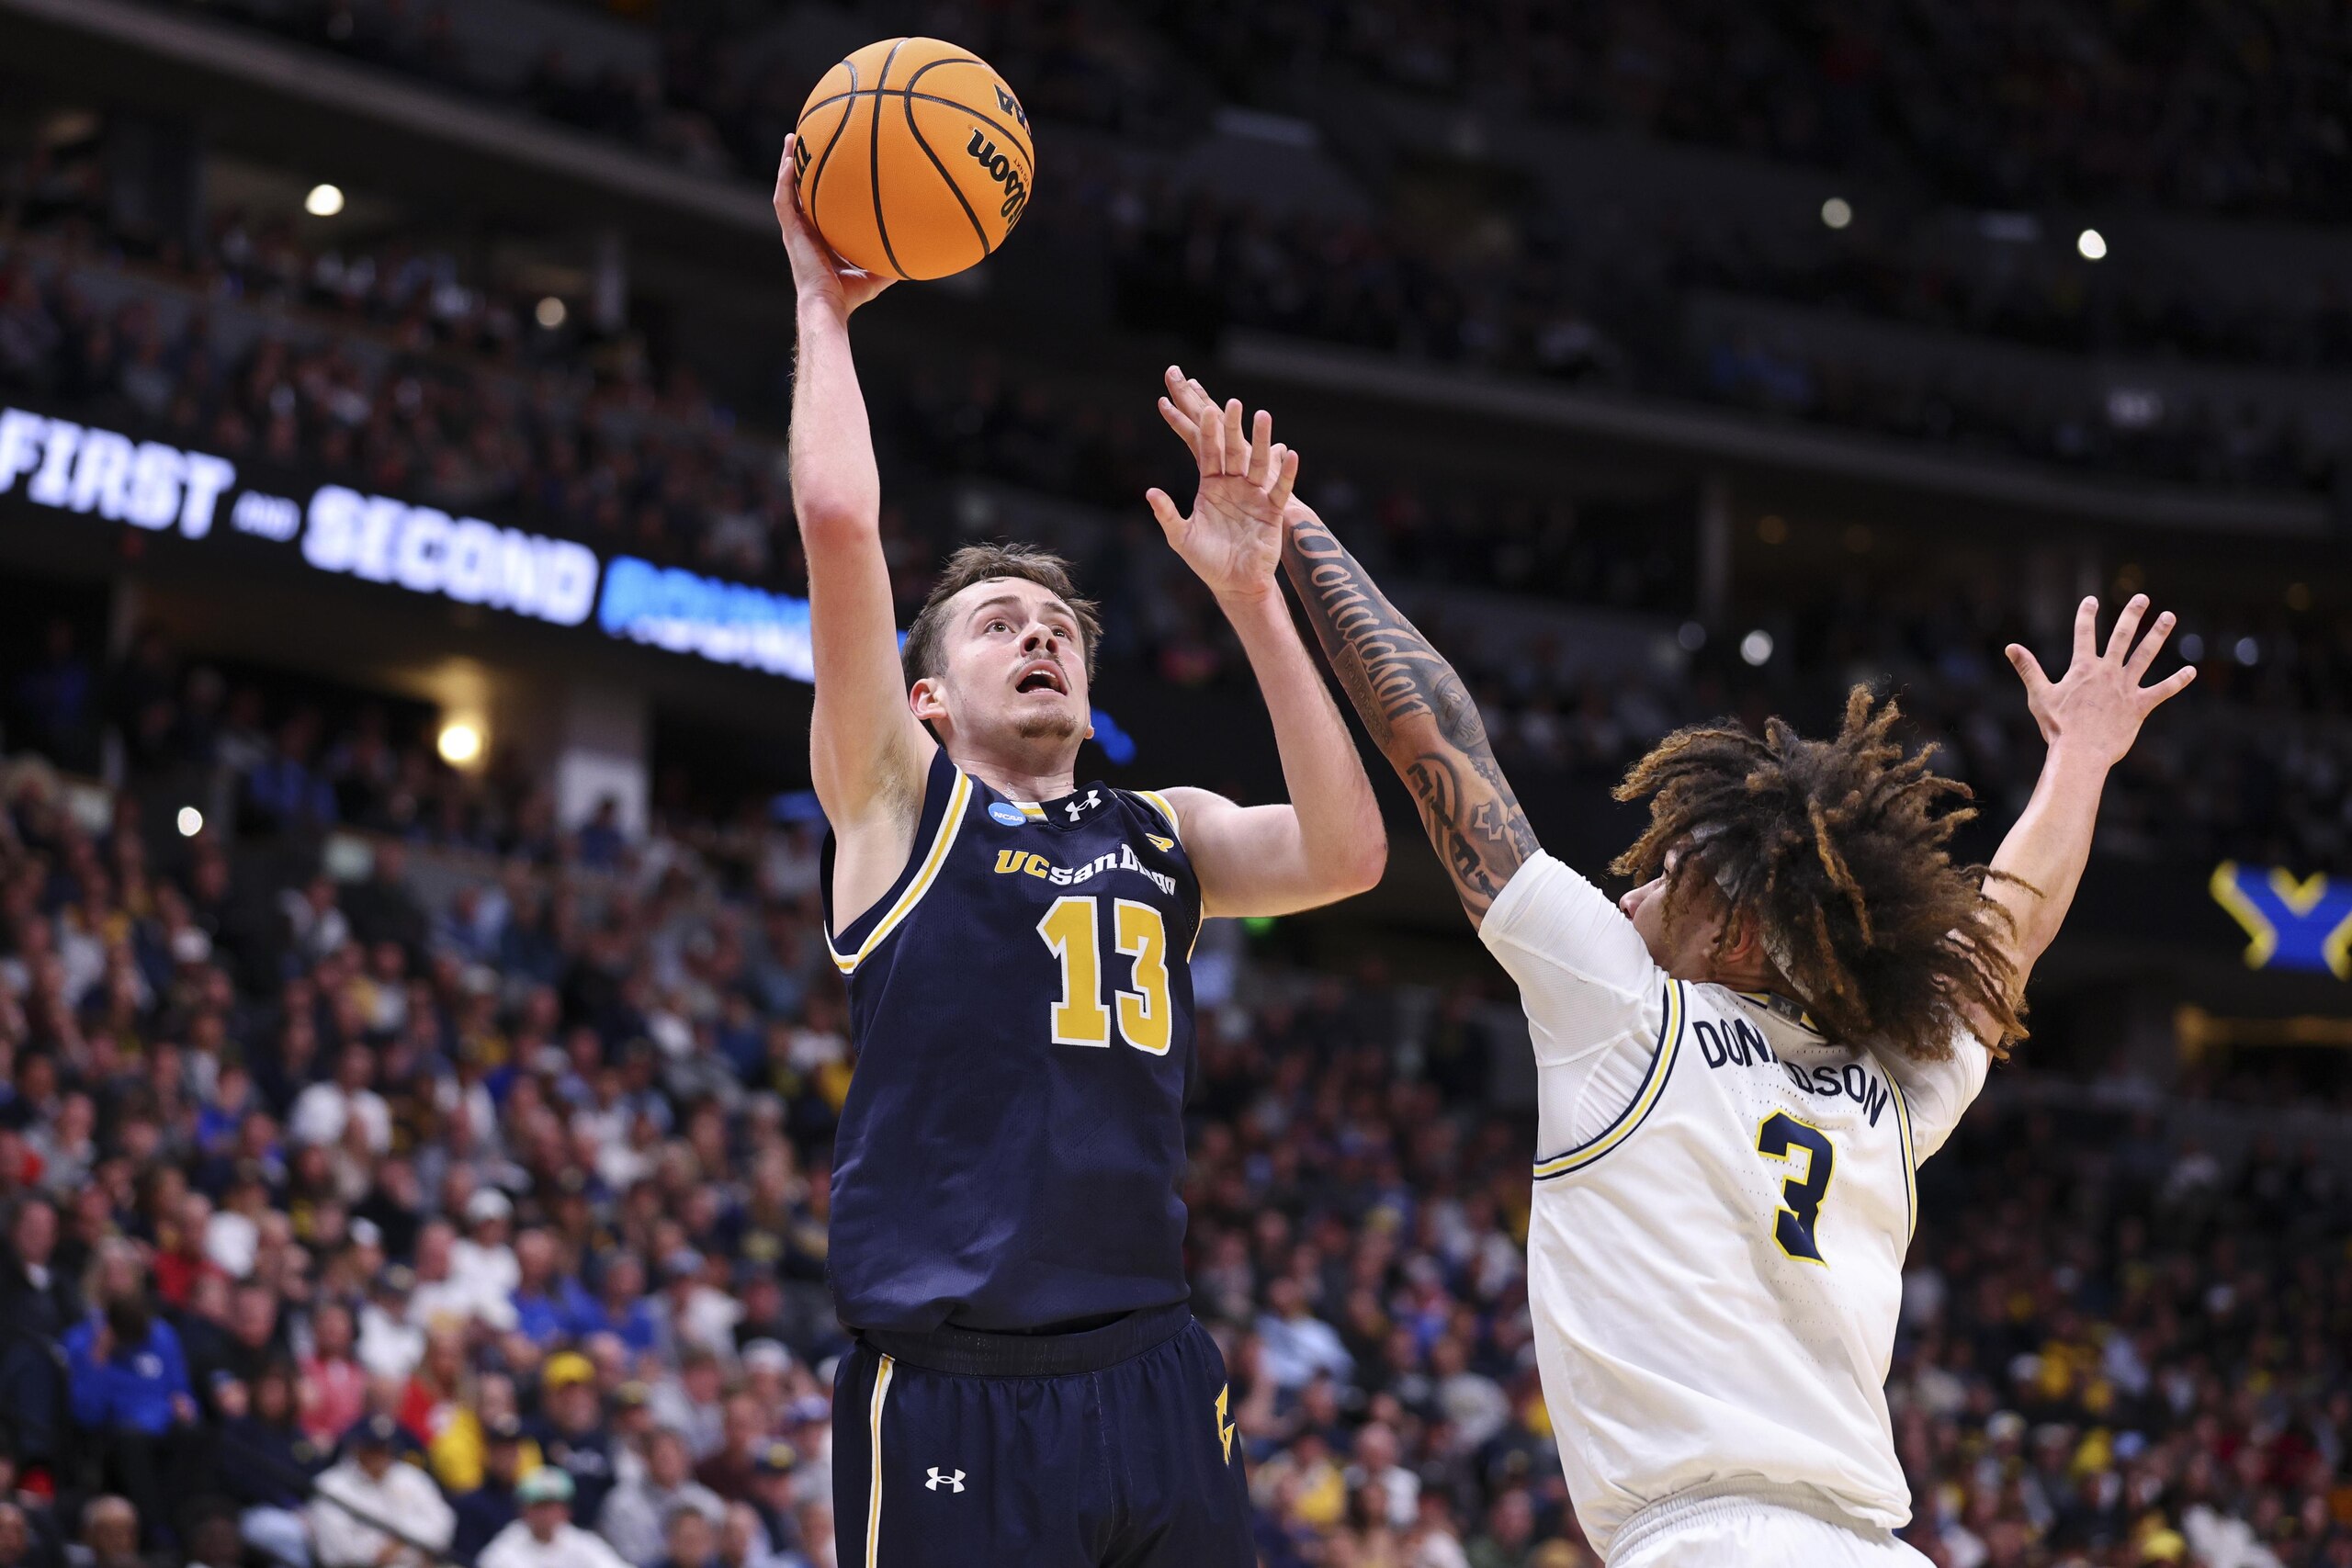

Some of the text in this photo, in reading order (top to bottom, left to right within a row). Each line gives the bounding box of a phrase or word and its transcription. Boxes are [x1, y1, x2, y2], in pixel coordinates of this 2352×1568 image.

[0, 407, 236, 540] FIRST
[301, 484, 600, 626] SECOND
[993, 811, 1024, 822] NCAA
[1036, 895, 1173, 1056] 13
[1692, 1018, 1888, 1128] DONDSON
[1756, 1108, 1836, 1269] 3
